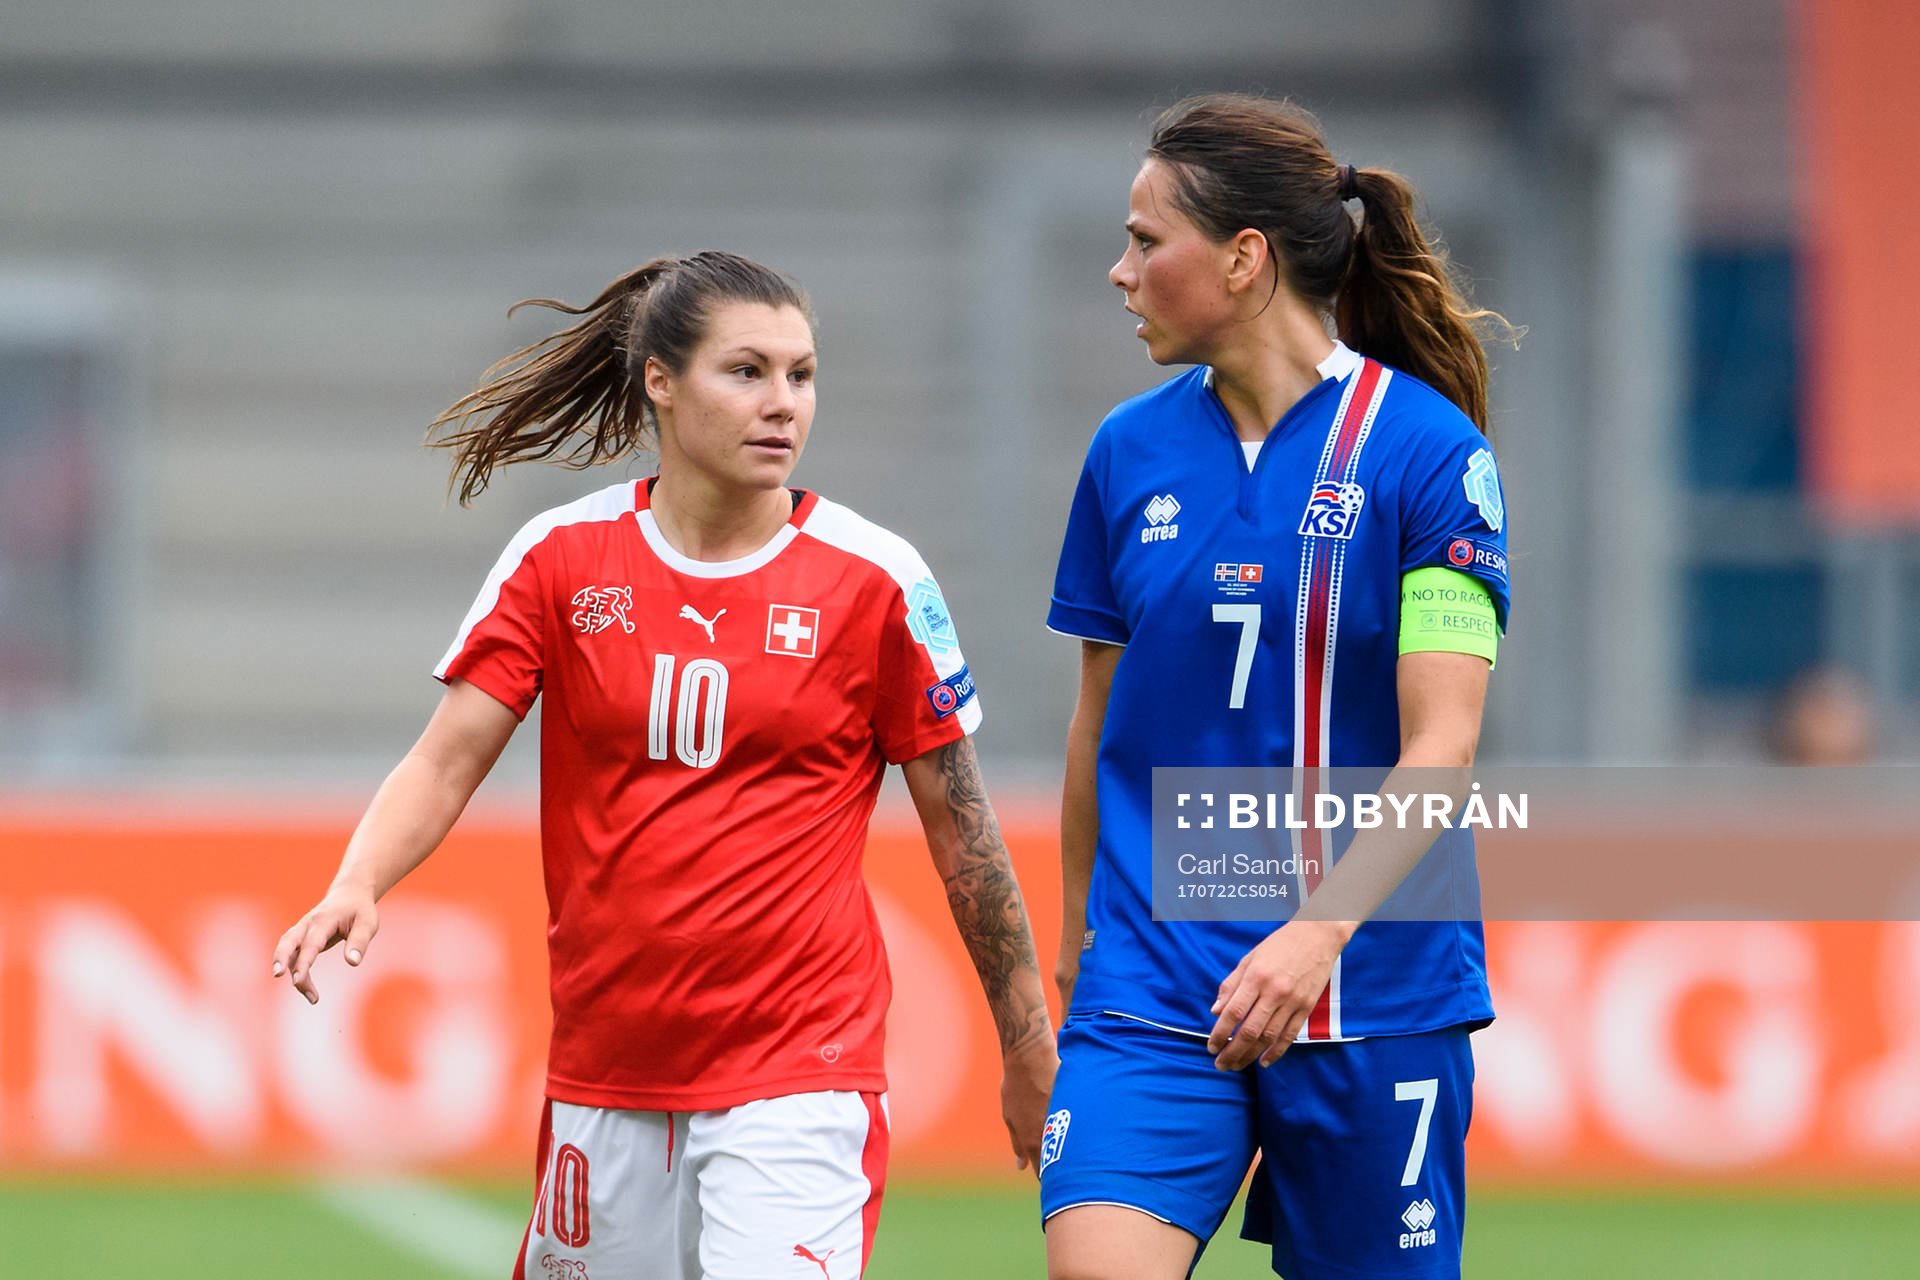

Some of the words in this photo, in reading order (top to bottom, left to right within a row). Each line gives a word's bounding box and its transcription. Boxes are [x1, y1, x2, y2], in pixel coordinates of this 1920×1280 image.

[1141, 523, 1179, 544] errea
[1412, 589, 1434, 602] NO
[1438, 588, 1457, 602] TO
[1443, 615, 1493, 634] RESPECT
[1212, 604, 1262, 709] 7
[648, 653, 730, 769] 10
[0, 890, 518, 1165] NG
[1395, 1079, 1439, 1187] 7
[1399, 1228, 1437, 1249] errea
